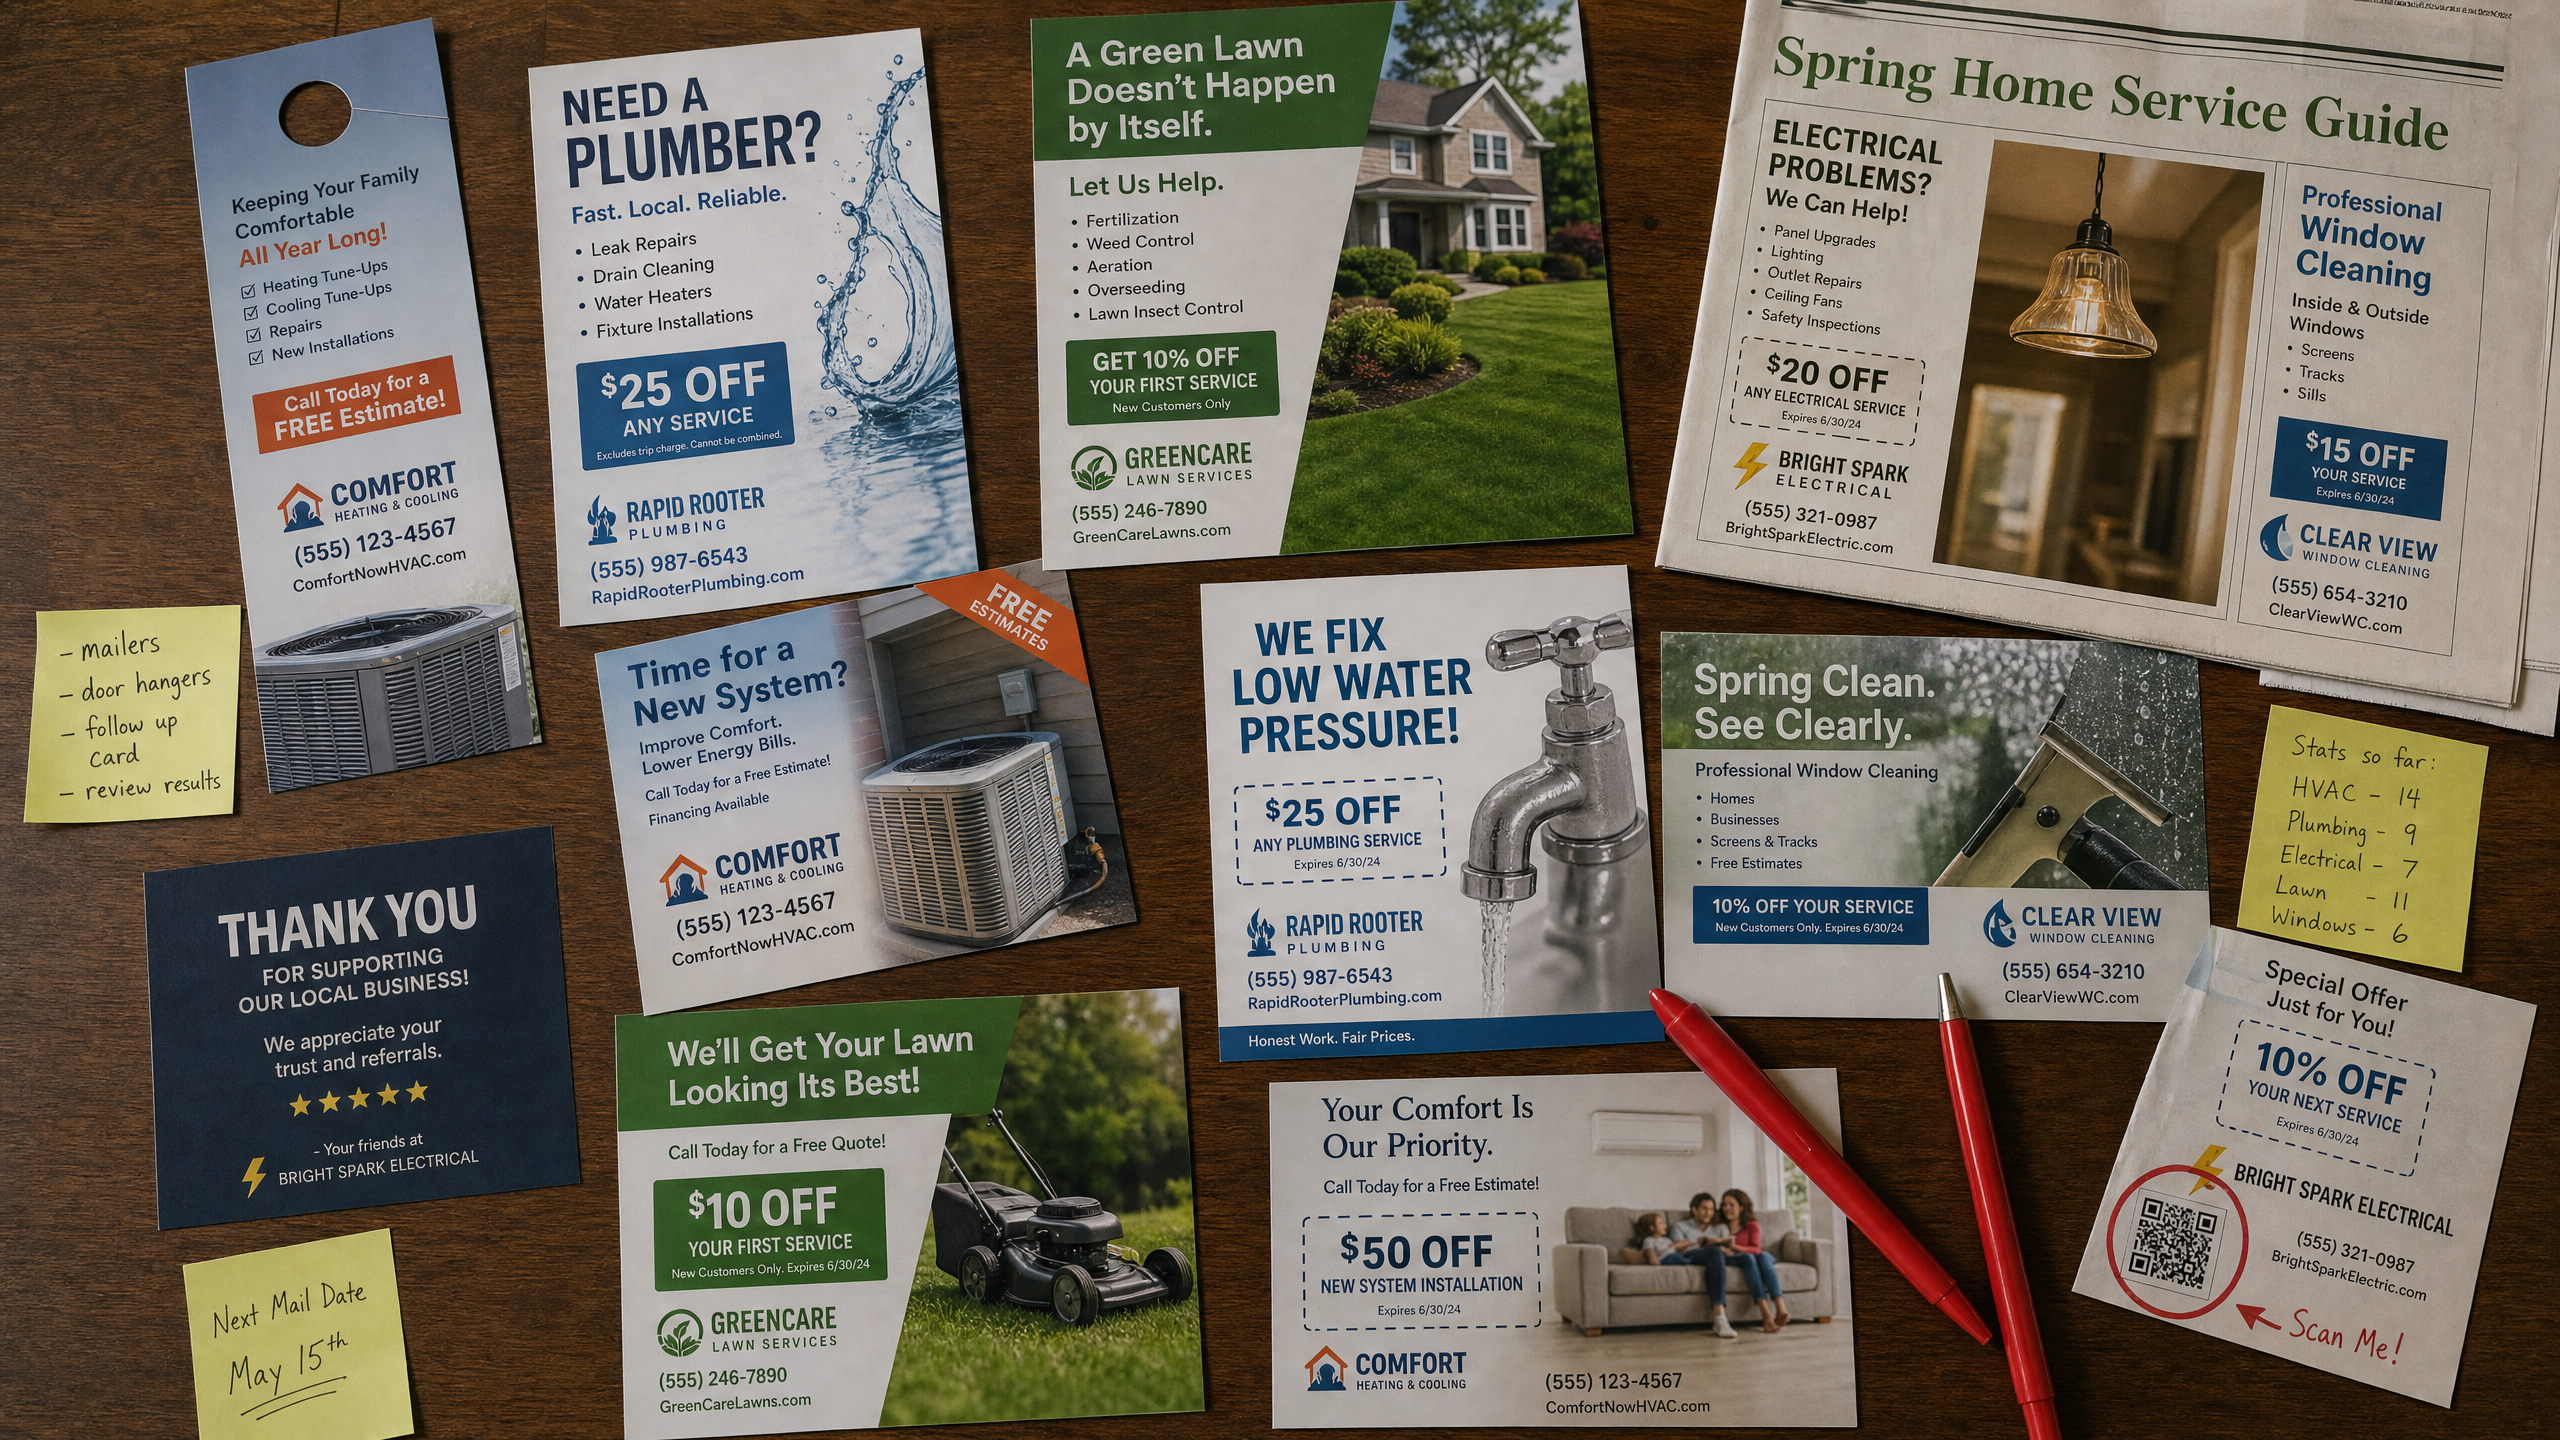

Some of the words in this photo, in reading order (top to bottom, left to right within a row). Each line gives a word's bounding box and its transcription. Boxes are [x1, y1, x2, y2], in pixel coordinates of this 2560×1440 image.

[562, 81, 667, 126] NEED
[681, 76, 708, 113] A
[1773, 36, 1936, 103] Spring
[1950, 56, 2093, 110] Home
[2110, 74, 2286, 132] Service
[2305, 95, 2448, 150] Guide
[566, 110, 821, 188] PLUMBER?
[1773, 118, 1942, 165] ELECTRICAL
[232, 189, 308, 214] Keeping
[313, 180, 354, 198] Your
[360, 165, 419, 189] Family
[1070, 176, 1109, 196] Let
[1118, 173, 1150, 194] Us
[1158, 171, 1223, 196] Help.
[1768, 152, 1931, 195] PROBLEMS?
[572, 204, 622, 224] Fast.
[629, 194, 690, 217] Local.
[697, 184, 786, 210] Reliable.
[1087, 211, 1178, 227] Fertilization
[2302, 184, 2442, 222] Professional
[235, 203, 354, 239] Comfortable
[1774, 224, 1809, 239] Panel
[1814, 229, 1875, 248] Upgrades
[2300, 214, 2425, 254] Window
[239, 245, 268, 268] All
[273, 239, 321, 260] Year
[328, 221, 387, 250] Long!
[263, 275, 317, 294] Heating
[320, 261, 387, 282] Tune-Ups
[593, 266, 637, 283] Drain
[643, 258, 714, 277] Cleaning
[1088, 279, 1185, 296] Overseeding
[2296, 249, 2431, 296] Cleaning
[1761, 308, 1803, 328] Safety
[1807, 314, 1880, 335] Inspections
[1093, 350, 1136, 371] GET
[1143, 348, 1189, 369] 10%
[1196, 346, 1239, 367] OFF
[2301, 343, 2354, 361] Screens
[2299, 364, 2344, 382] Tracks
[1112, 403, 1138, 413] New
[1141, 401, 1201, 411] Customers
[1204, 398, 1230, 410] Only
[2297, 386, 2326, 402] Sills
[274, 411, 333, 441] FREE
[339, 388, 445, 427] Estimate!
[596, 448, 636, 460] Excludes
[638, 445, 654, 456] trip
[655, 443, 688, 453] charge.
[690, 438, 722, 448] Cannot
[724, 436, 735, 444] be
[736, 429, 782, 443] combined.
[1125, 441, 1252, 469] GREENCARE
[2305, 429, 2350, 462] $15
[2359, 441, 2415, 470] OFF
[331, 460, 456, 506] COMFORT
[1126, 473, 1169, 486] LAWN
[1177, 469, 1251, 483] SERVICES
[1778, 450, 1847, 475] BRIGHT
[1850, 459, 1909, 483] SPARK
[1775, 473, 1891, 499] ELECTRICAL
[334, 502, 387, 522] HEATING
[392, 500, 400, 510] &
[404, 488, 458, 507] COOLING
[626, 496, 684, 523] RAPID
[689, 486, 765, 515] ROOTER
[629, 518, 725, 540] PLUMBING
[1725, 521, 1893, 554] BrightSparkElectric.com
[293, 550, 466, 592] ComfortNowHVAC.com
[2302, 550, 2360, 568] WINDOW
[2365, 559, 2429, 579] CLEANING
[592, 569, 804, 606] RapidRooterPlumbing.com
[986, 582, 1052, 631] FREE
[969, 599, 1048, 650] ESTIMATES
[83, 630, 160, 661] mailers
[83, 676, 124, 701] door
[136, 669, 211, 700] hangers
[633, 694, 705, 726] New
[715, 660, 847, 713] System?
[1233, 665, 1321, 705] LOW
[1333, 658, 1472, 700] WATER
[1694, 662, 1811, 703] Spring
[1822, 661, 1934, 697] Clean.
[86, 715, 143, 739] follow
[156, 716, 177, 736] up
[1240, 706, 1458, 754] PRESSURE!
[1694, 706, 1764, 739] See
[1775, 707, 1911, 748] Clearly.
[642, 756, 692, 775] Lower
[697, 743, 753, 764] Energy
[758, 733, 796, 751] Bills.
[2292, 735, 2346, 761] Stats
[2362, 751, 2380, 764] so
[86, 780, 151, 799] review
[165, 769, 221, 793] results
[2293, 776, 2356, 801] HVAC
[2399, 787, 2420, 809] 14
[648, 805, 711, 826] Financing
[714, 792, 769, 812] Available
[1711, 812, 1779, 825] Businesses
[2288, 810, 2366, 847] Plumbing
[2405, 823, 2416, 845] 9
[2281, 845, 2362, 871] Electrical
[2403, 859, 2418, 878] 7
[2276, 875, 2326, 900] Lawn
[2394, 892, 2408, 910] 11
[217, 896, 379, 957] THANK
[384, 884, 476, 937] YOU
[1715, 922, 1738, 932] New
[1740, 922, 1794, 932] Customers
[1796, 922, 1822, 934] Only.
[1825, 922, 1860, 934] Expires
[1863, 922, 1903, 933] 6/30/24
[2022, 906, 2095, 926] CLEAR
[2101, 907, 2161, 927] VIEW
[2272, 906, 2356, 935] Windows
[2393, 923, 2408, 943] 6
[672, 922, 854, 966] ComfortNowHVAC.com
[2003, 961, 2050, 981] (555)
[2056, 963, 2144, 979] 654-3210
[2265, 959, 2344, 996] Special
[2351, 982, 2408, 1011] Offer
[1248, 1034, 1295, 1047] Honest
[1299, 1032, 1337, 1045] Work.
[1342, 1030, 1366, 1043] Fair
[1370, 1029, 1414, 1042] Prices.
[274, 1058, 317, 1077] trust
[323, 1051, 355, 1071] and
[361, 1042, 441, 1067] referrals.
[669, 1074, 787, 1107] Looking
[798, 1072, 835, 1098] Its
[844, 1066, 919, 1096] Best!
[1323, 1133, 1377, 1158] Our
[1387, 1131, 1492, 1163] Priority.
[2276, 1116, 2314, 1134] Expires
[2317, 1127, 2358, 1146] 6/30/24
[1321, 1278, 1355, 1293] NEW
[1359, 1277, 1416, 1293] SYSTEM
[1421, 1275, 1522, 1292] INSTALLATION
[2271, 1249, 2426, 1301] BrightSparkElectric.com
[214, 1305, 259, 1338] Next
[272, 1287, 310, 1320] Mail
[321, 1282, 366, 1308] Date
[2289, 1308, 2343, 1349] Scan
[2355, 1332, 2404, 1365] Me!
[230, 1356, 281, 1396] May
[660, 1395, 811, 1413] GreenCareLawns.com
